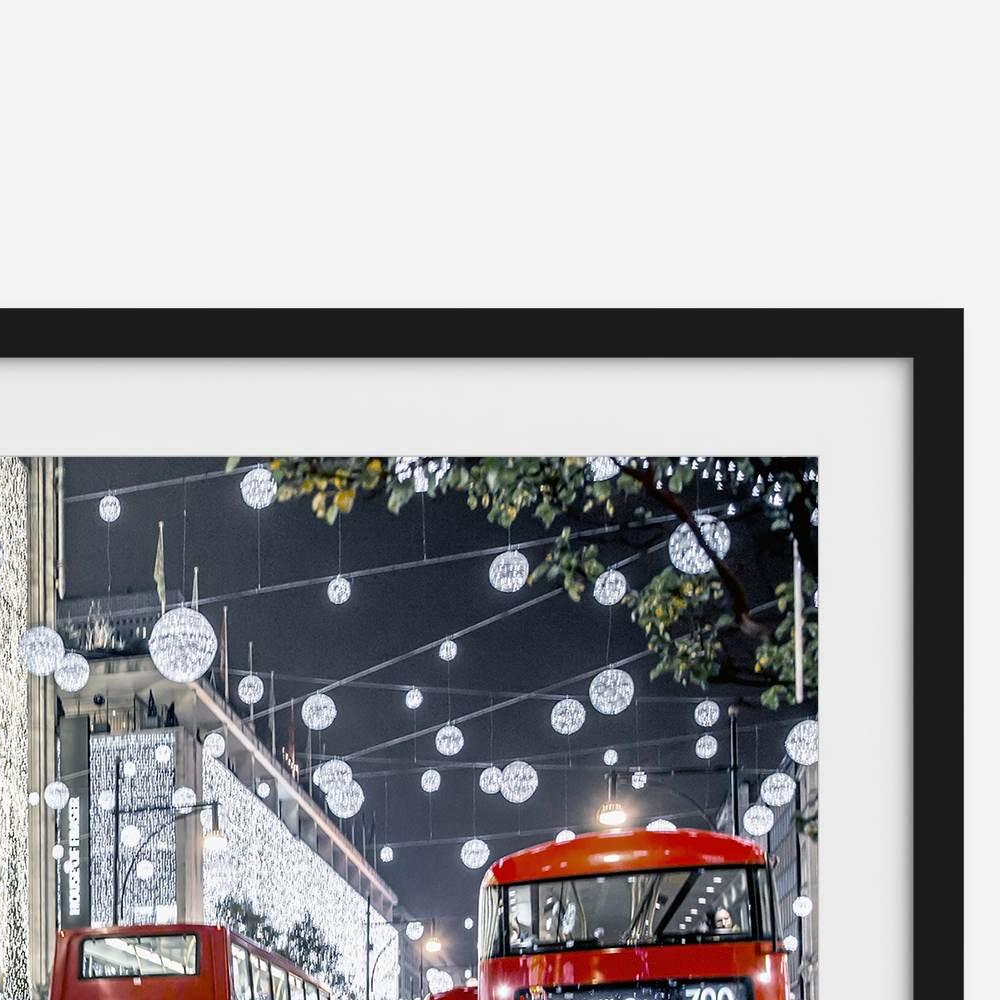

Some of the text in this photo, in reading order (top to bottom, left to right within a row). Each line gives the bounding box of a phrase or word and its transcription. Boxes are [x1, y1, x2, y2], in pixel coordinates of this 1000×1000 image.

[68, 796, 80, 916] HOUSE OF FRASER
